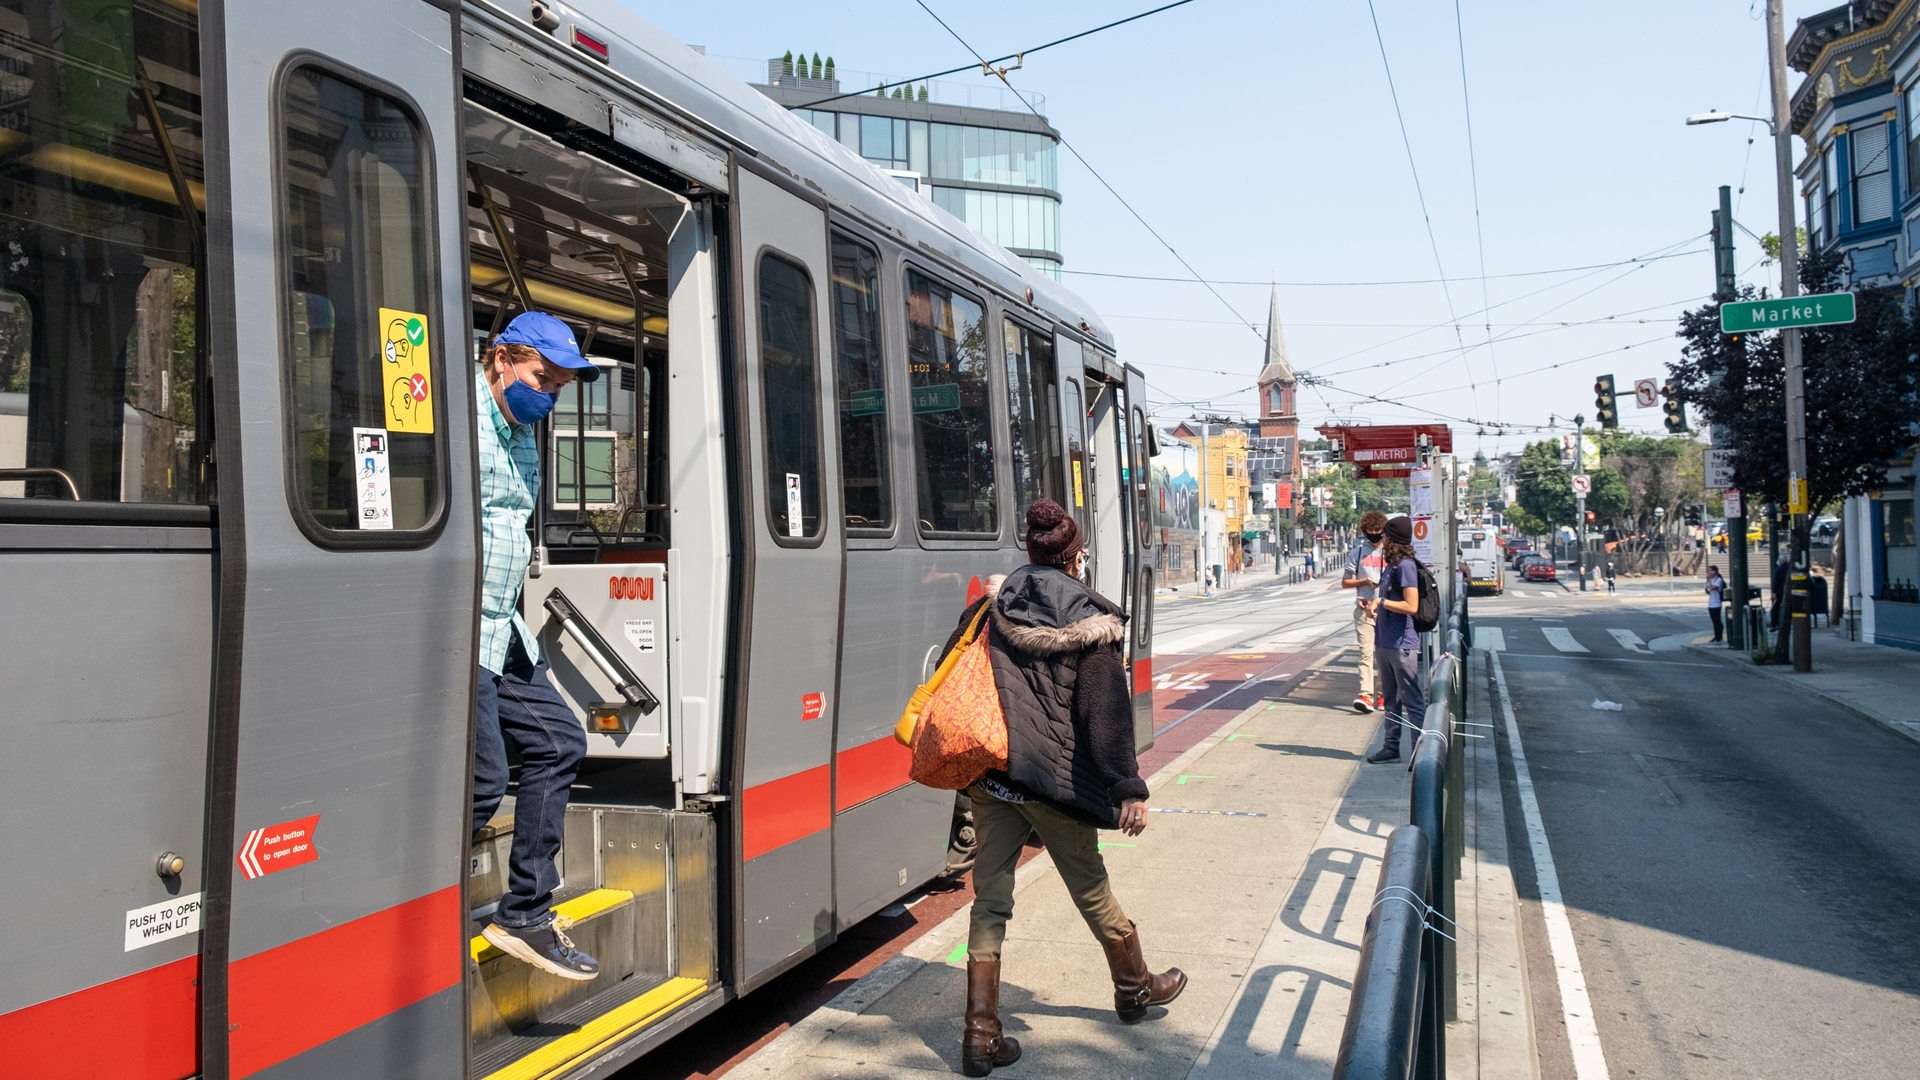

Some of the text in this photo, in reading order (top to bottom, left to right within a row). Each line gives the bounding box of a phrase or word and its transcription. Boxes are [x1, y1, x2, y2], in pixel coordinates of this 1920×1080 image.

[1752, 303, 1823, 323] Market
[1374, 449, 1408, 460] METRO
[1713, 452, 1730, 461] NO
[1714, 478, 1730, 486] RED
[264, 829, 305, 846] Push button
[263, 843, 309, 861] to open door
[129, 901, 203, 930] PUSH TO OPEN
[142, 916, 190, 938] WHEN LIT
